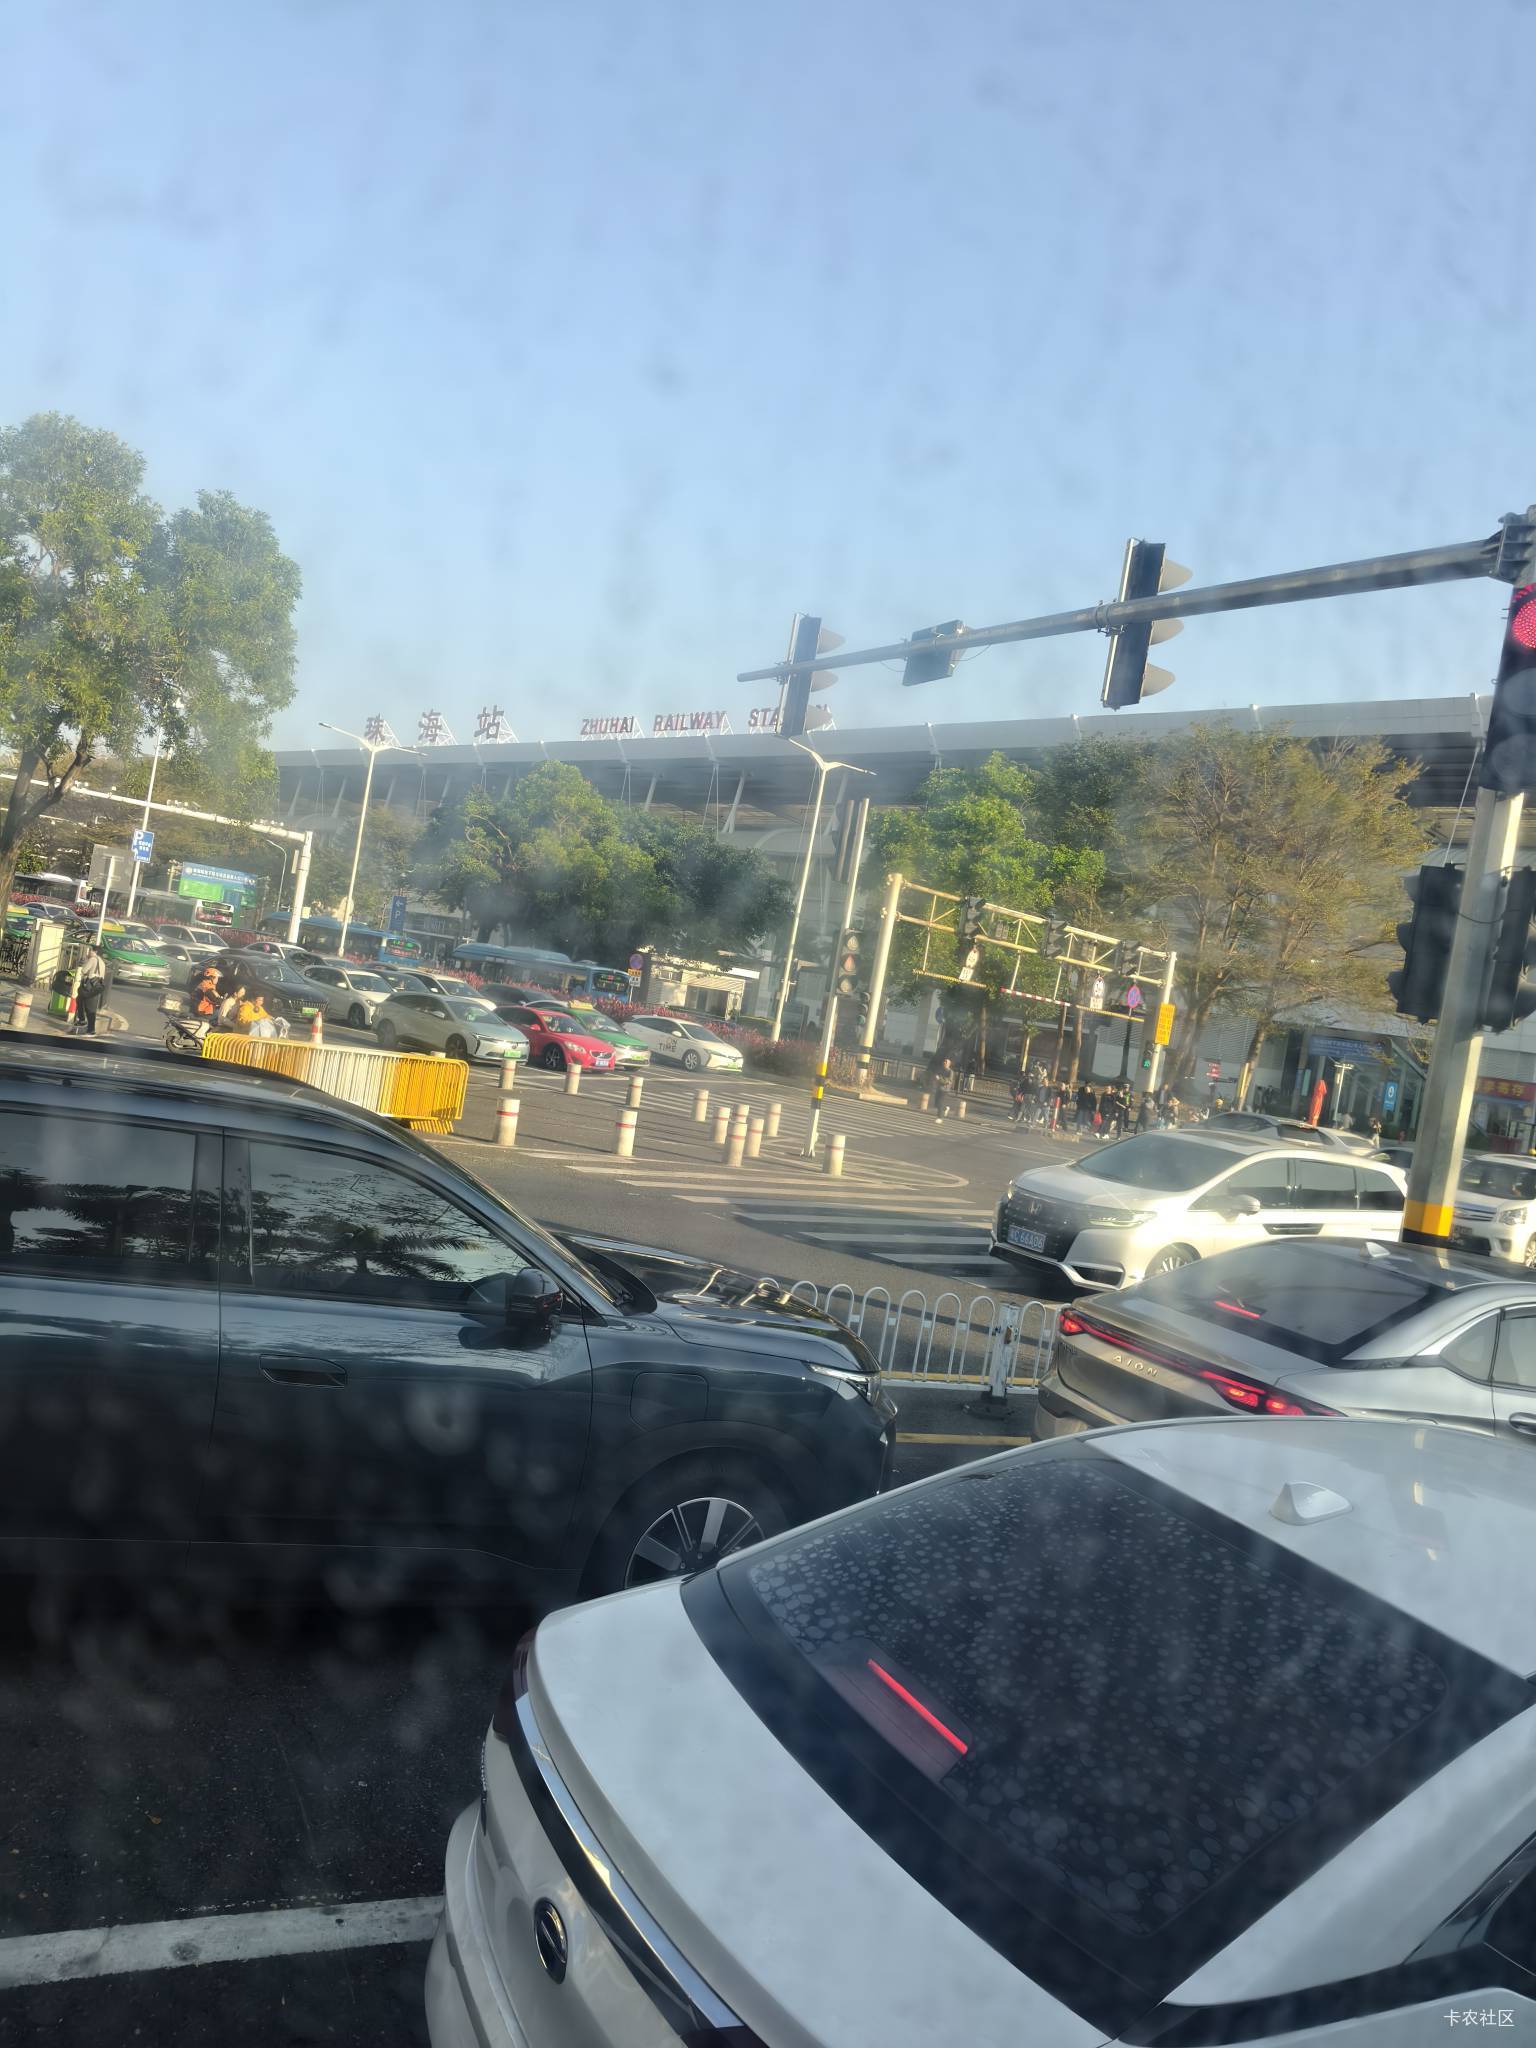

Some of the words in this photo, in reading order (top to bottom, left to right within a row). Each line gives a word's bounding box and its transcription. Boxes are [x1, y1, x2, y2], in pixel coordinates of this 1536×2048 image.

[364, 705, 505, 746] 珠海站
[580, 716, 634, 735] ZHUHAI
[653, 710, 727, 732] RAILWAY
[1112, 1354, 1158, 1377] AION
